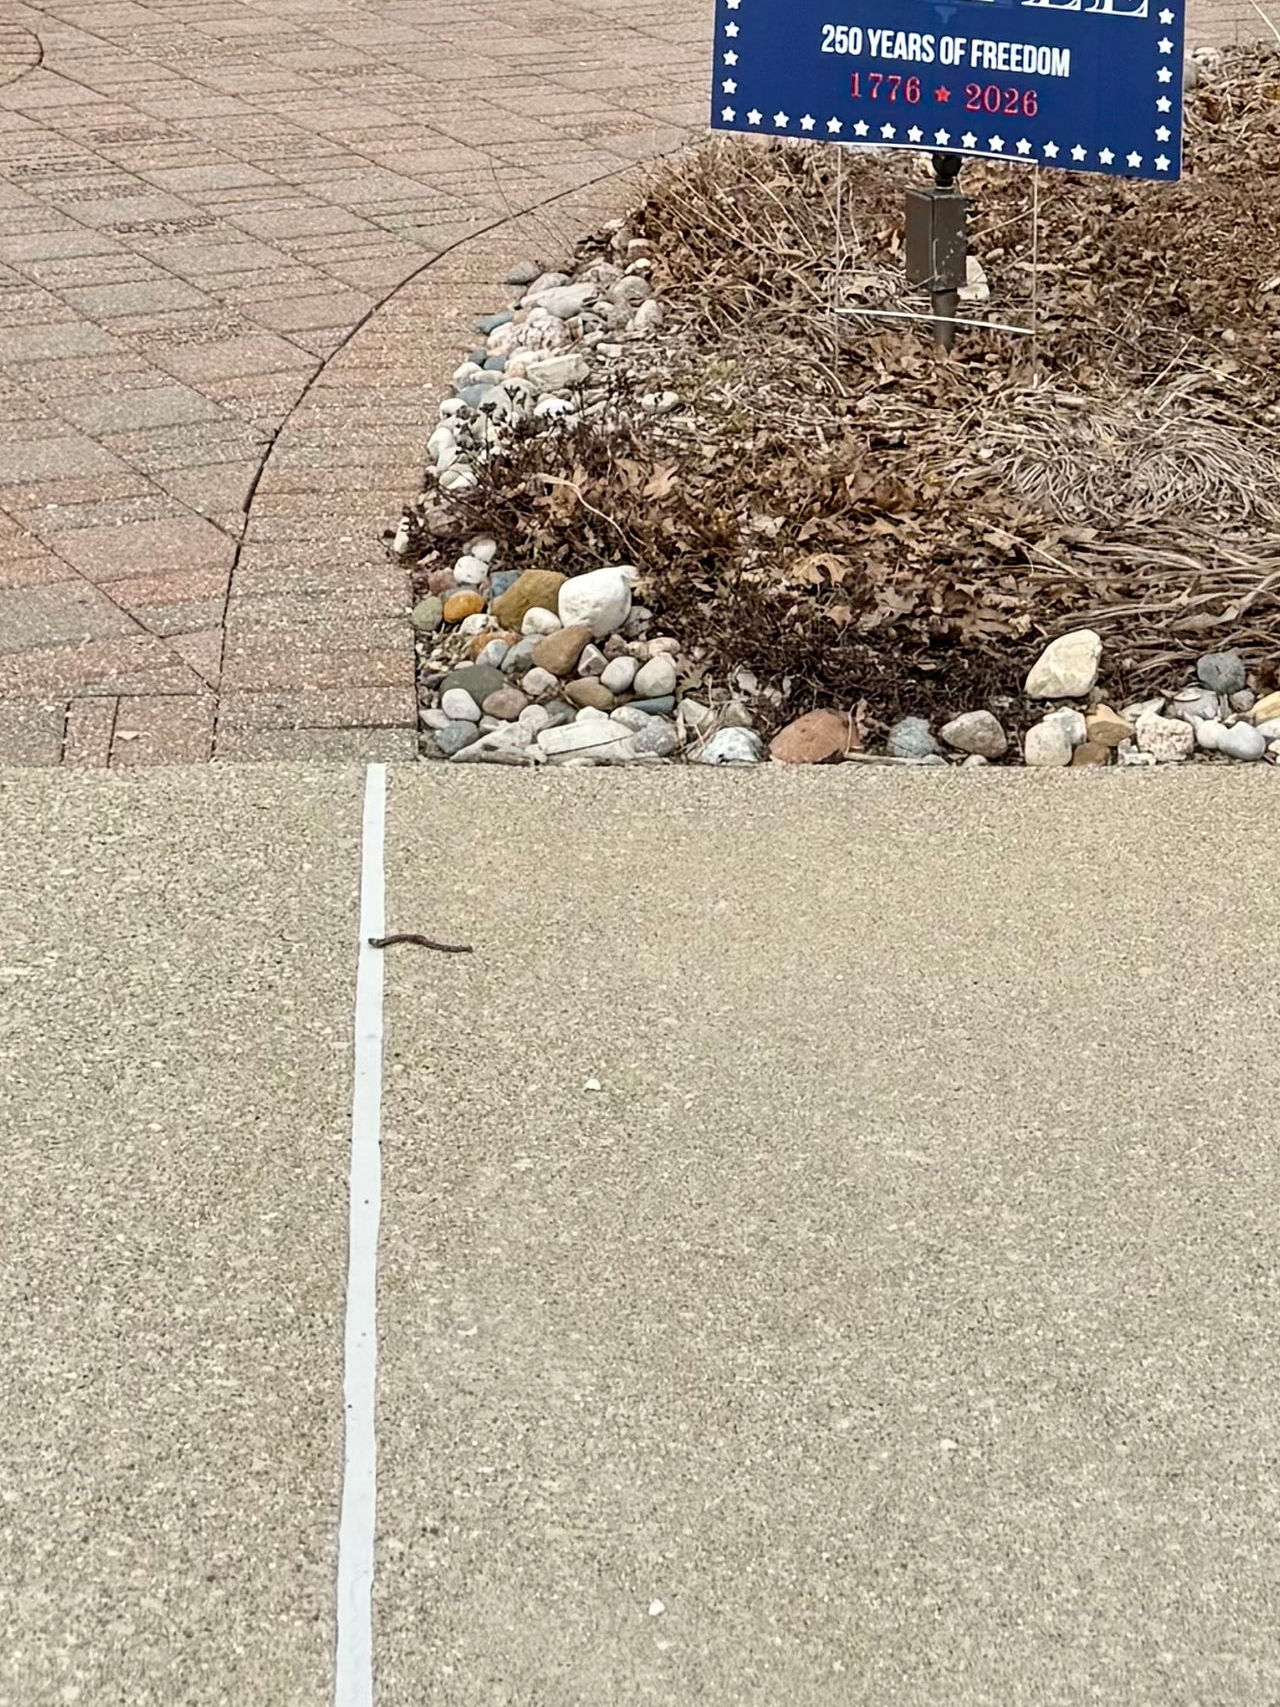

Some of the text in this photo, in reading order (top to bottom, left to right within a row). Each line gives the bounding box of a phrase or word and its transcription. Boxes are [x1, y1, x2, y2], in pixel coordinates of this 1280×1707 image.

[821, 24, 1071, 78] 250 YEARS OF FREEDOM
[850, 71, 1039, 117] 1776 2026
